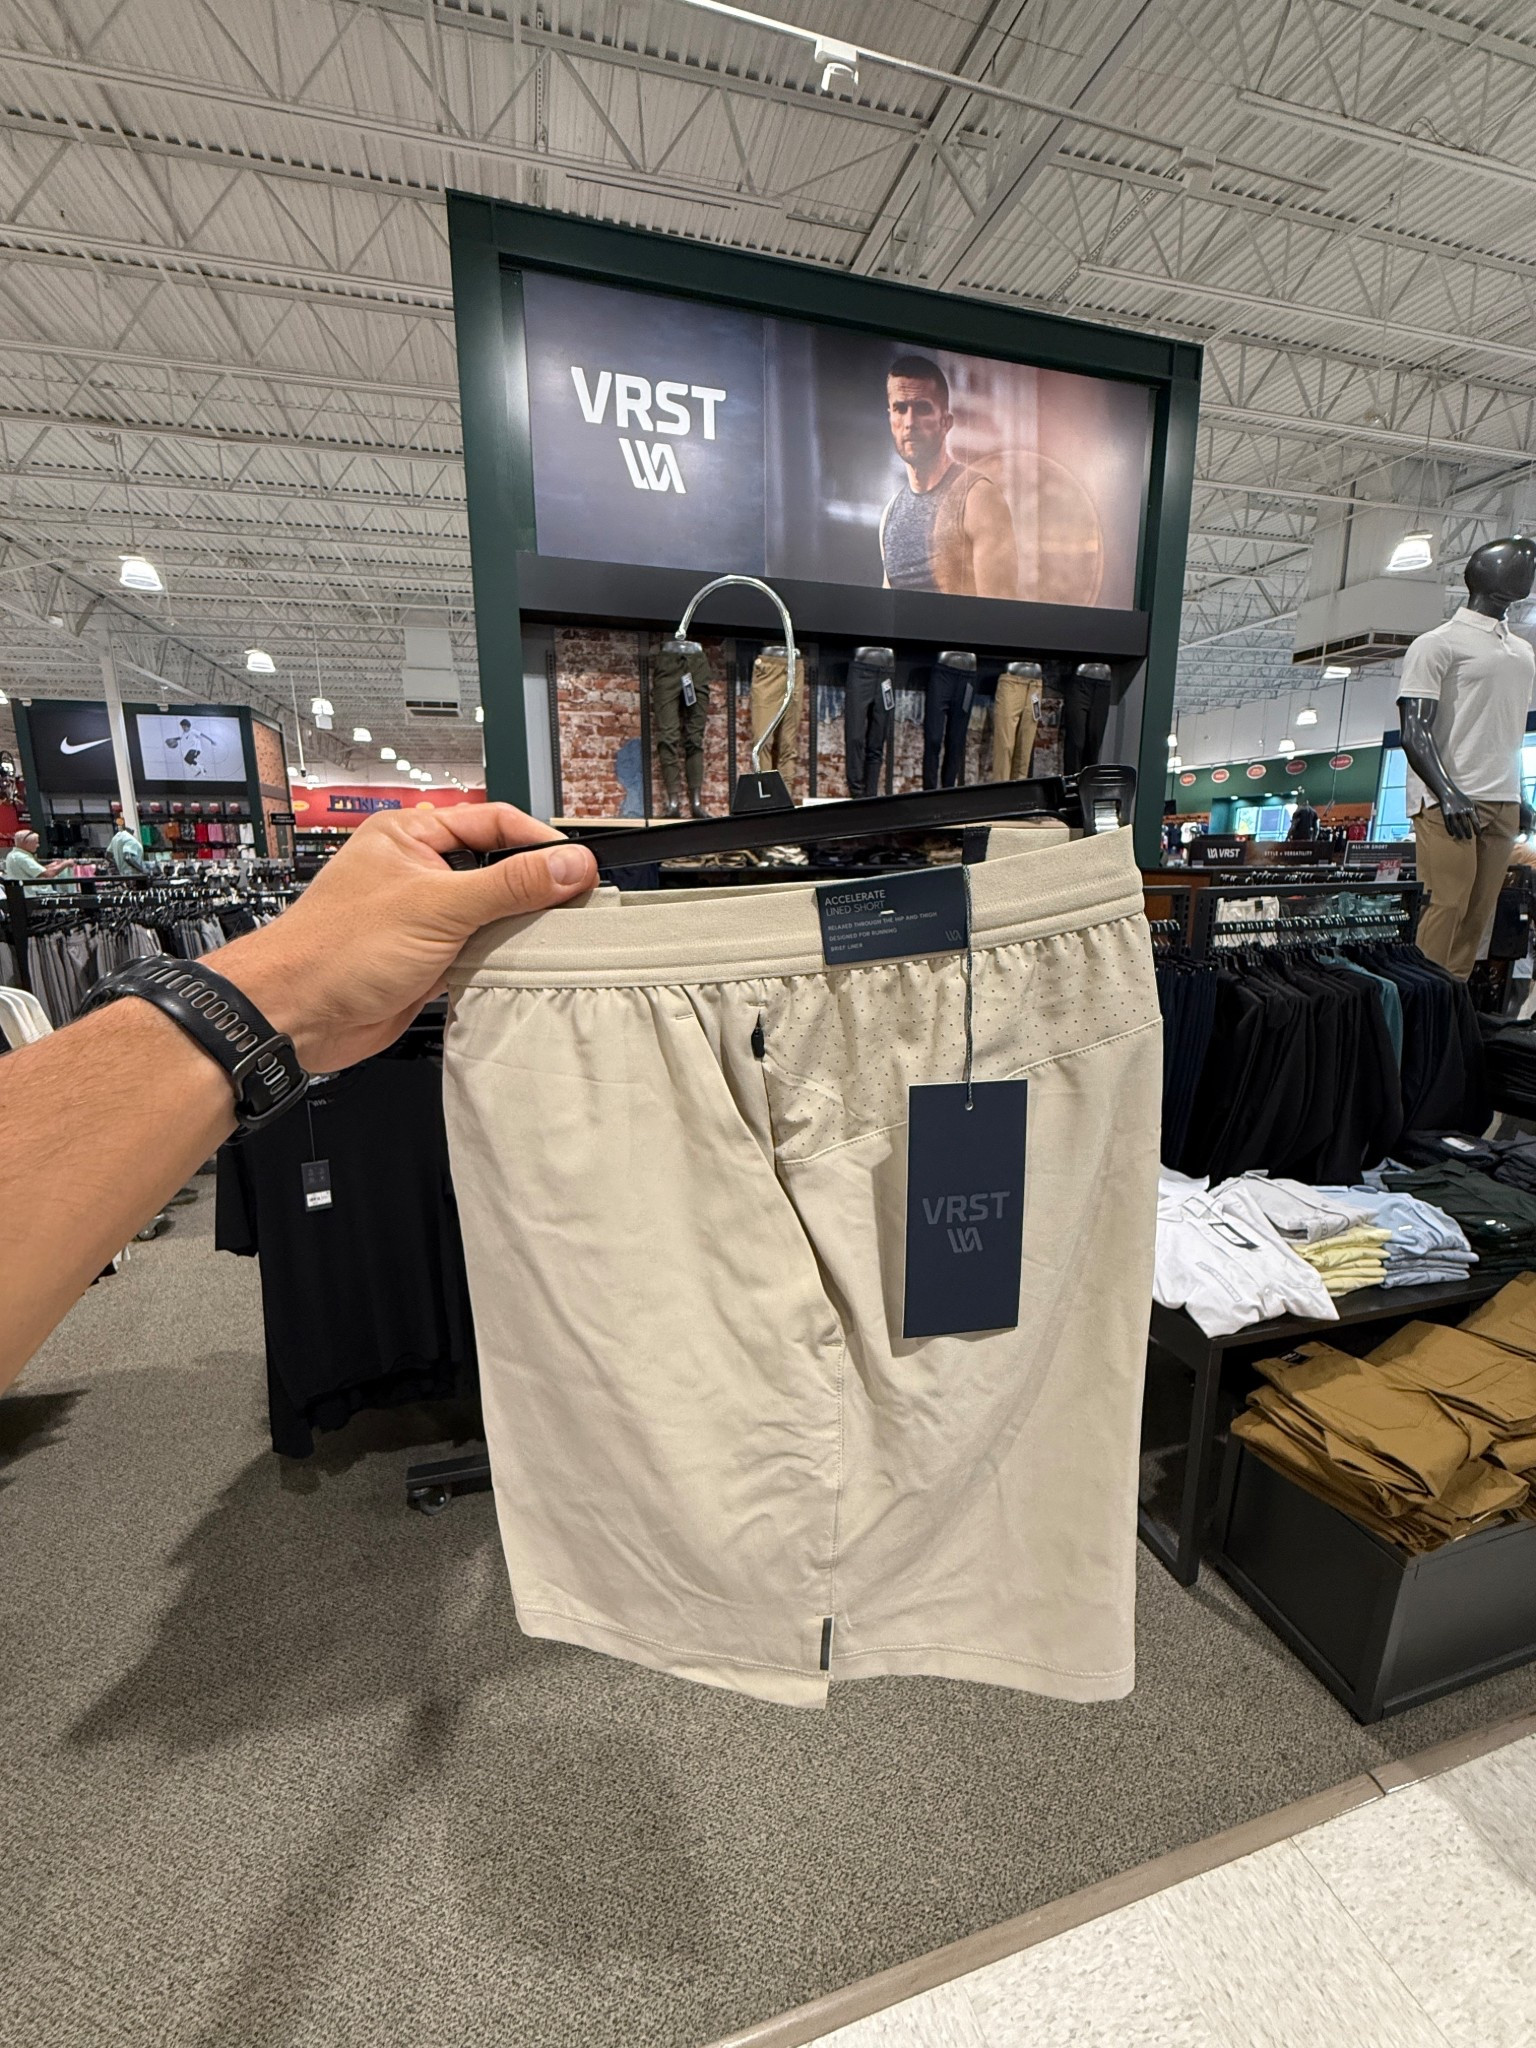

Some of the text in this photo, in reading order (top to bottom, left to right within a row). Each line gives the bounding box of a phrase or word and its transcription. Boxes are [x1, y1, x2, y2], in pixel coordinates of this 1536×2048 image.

[570, 366, 727, 440] VRST
[758, 781, 771, 799] L
[1219, 848, 1240, 858] VRST
[824, 889, 886, 906] ACCELERATE
[826, 900, 885, 917] LINED SHORT
[854, 918, 882, 927] THROUGH
[829, 933, 858, 942] DESIGNED
[922, 1191, 1011, 1225] VRST
